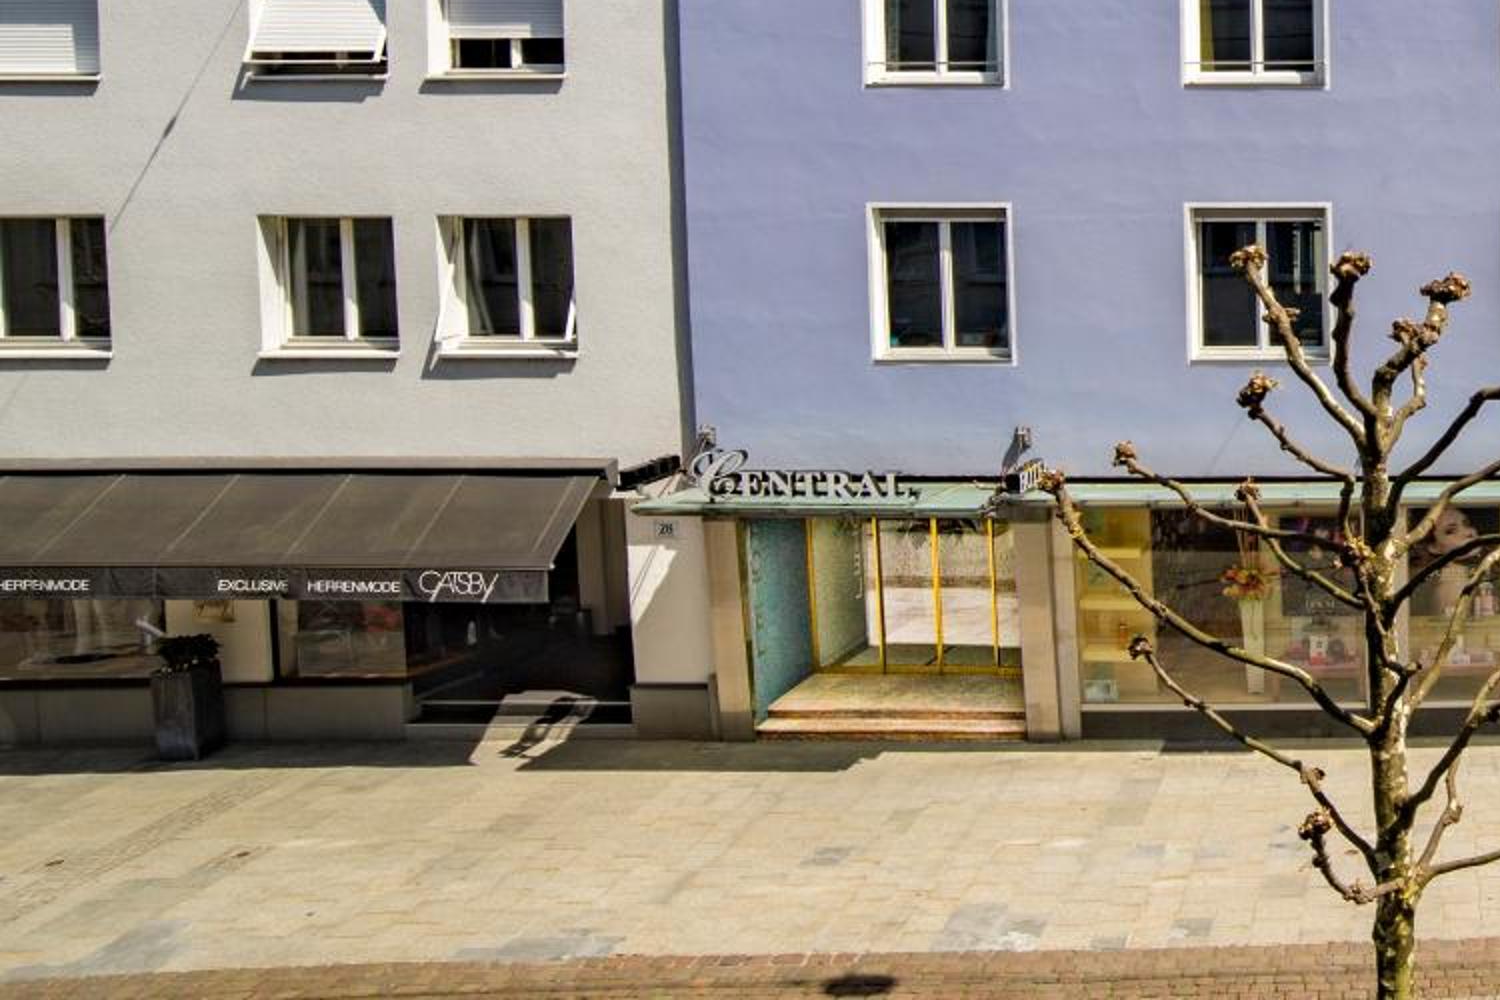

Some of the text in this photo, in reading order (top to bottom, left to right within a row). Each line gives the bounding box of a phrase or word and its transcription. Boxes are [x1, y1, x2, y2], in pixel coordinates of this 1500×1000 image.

[690, 448, 919, 502] CENTRAL
[217, 579, 289, 592] EXCLUSIVE
[306, 579, 400, 593] HERRENMODE
